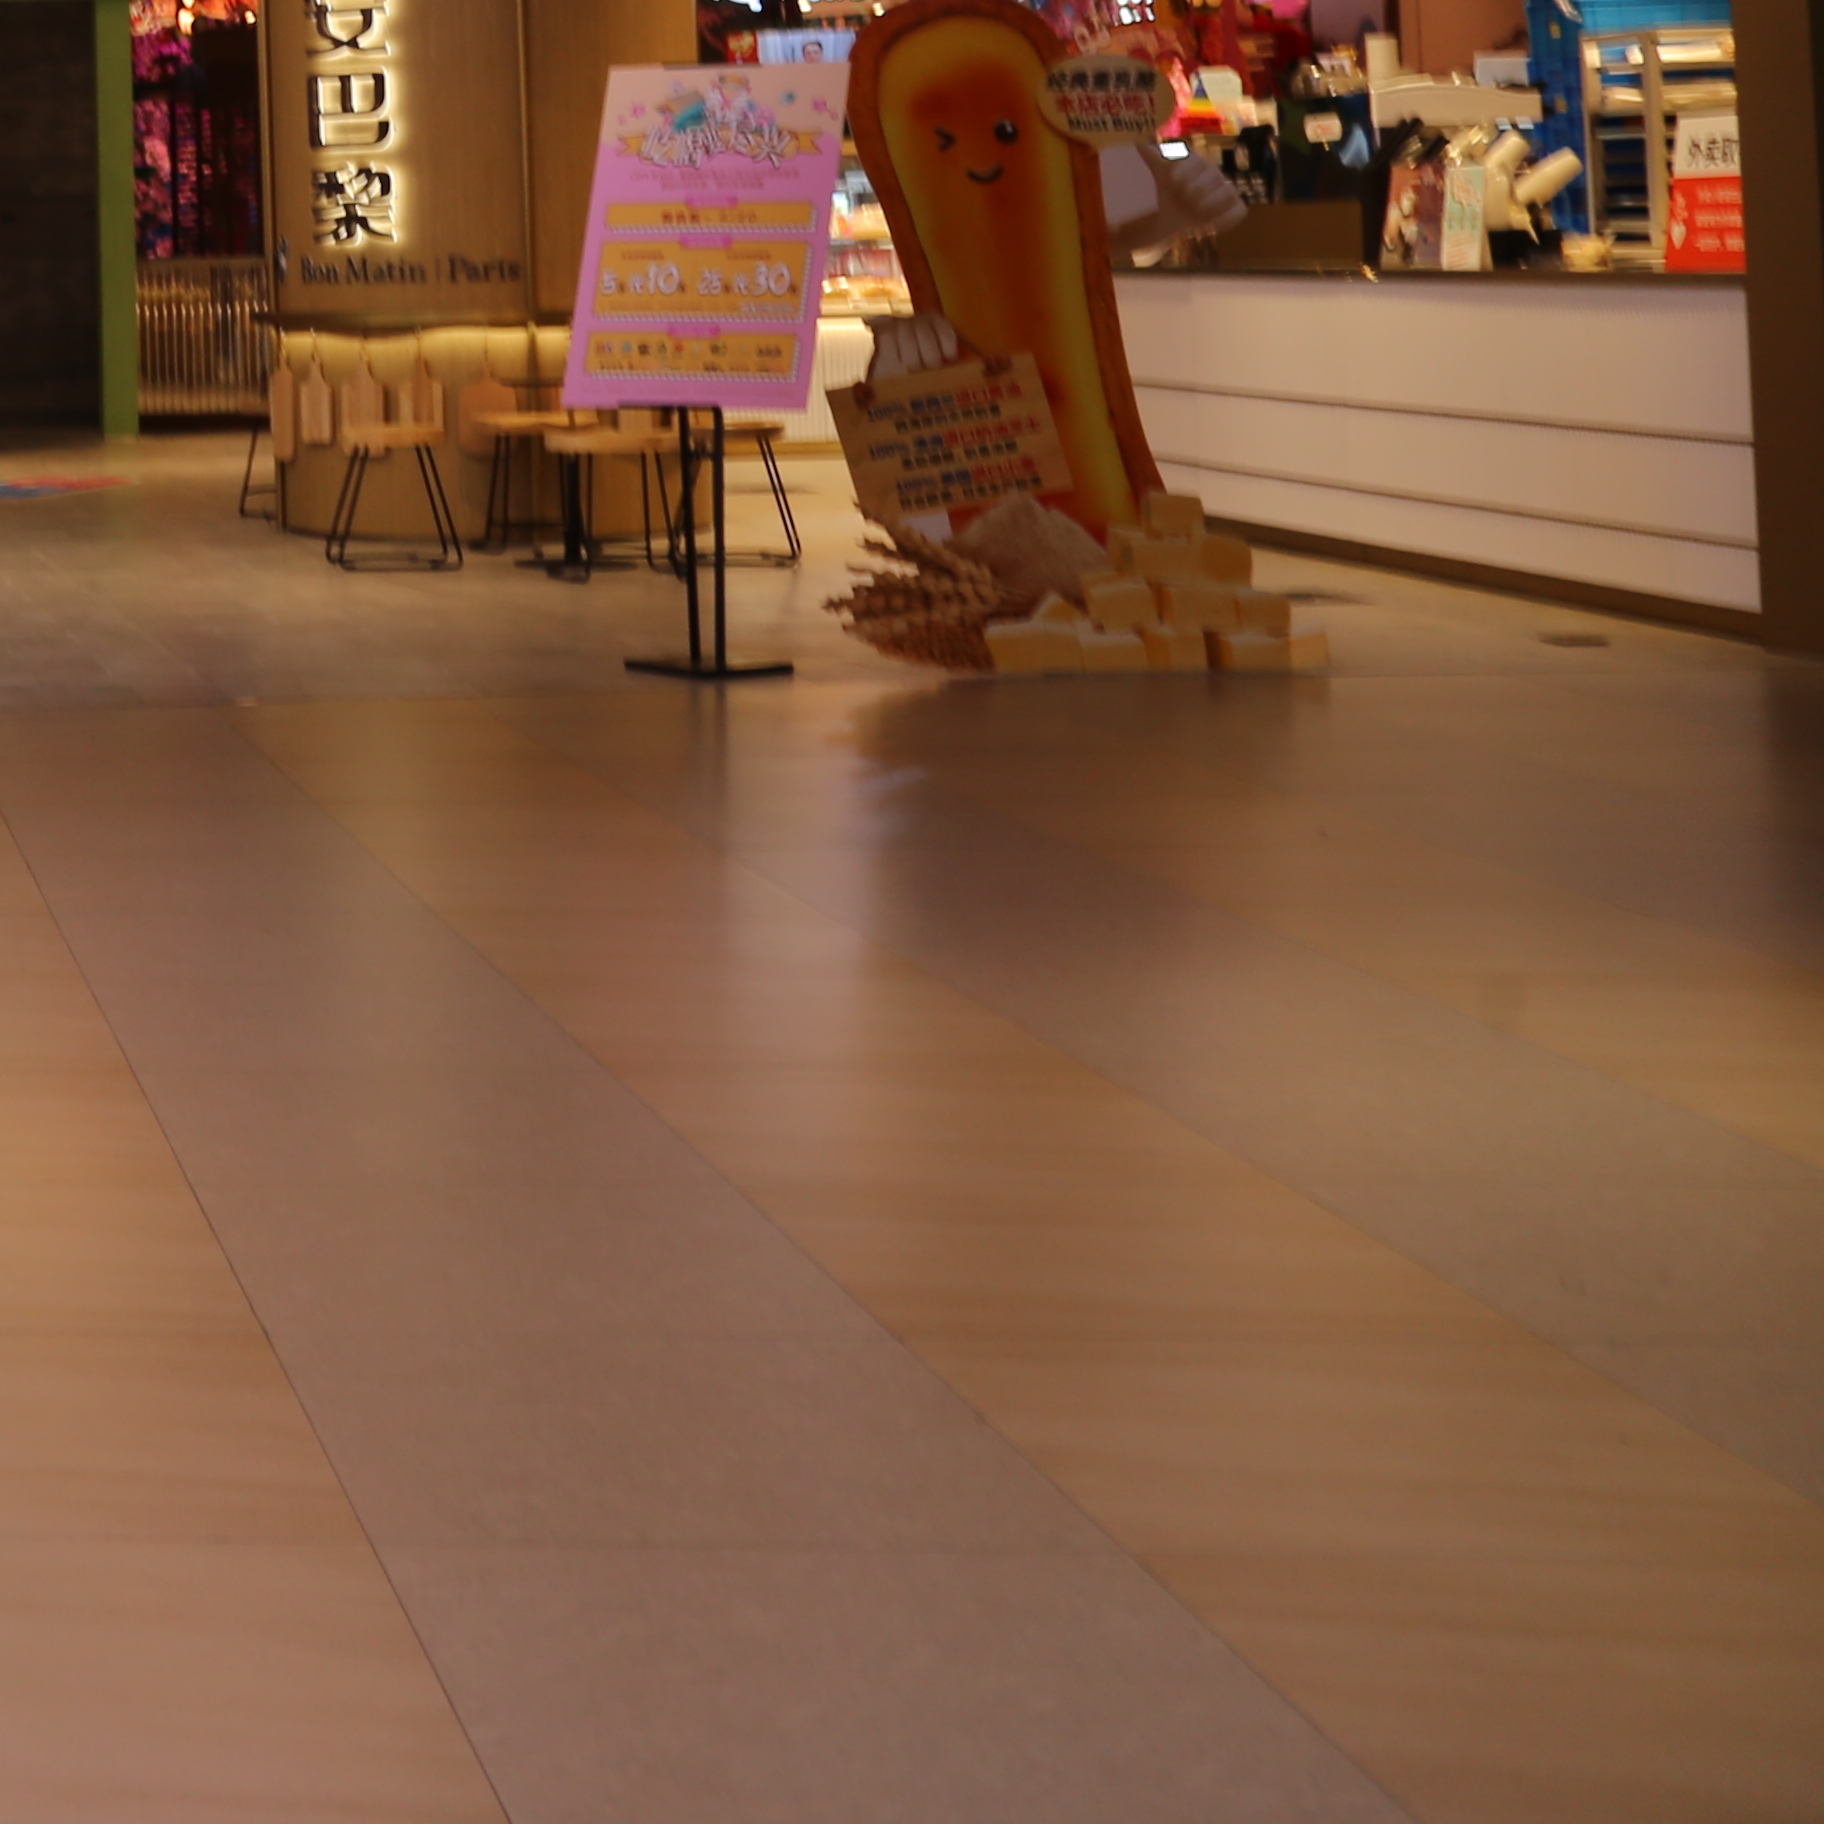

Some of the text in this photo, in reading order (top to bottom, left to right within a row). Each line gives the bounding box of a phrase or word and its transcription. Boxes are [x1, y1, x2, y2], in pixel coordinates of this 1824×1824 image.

[1067, 116, 1109, 132] Must
[301, 254, 521, 285] Bon Matin Paris
